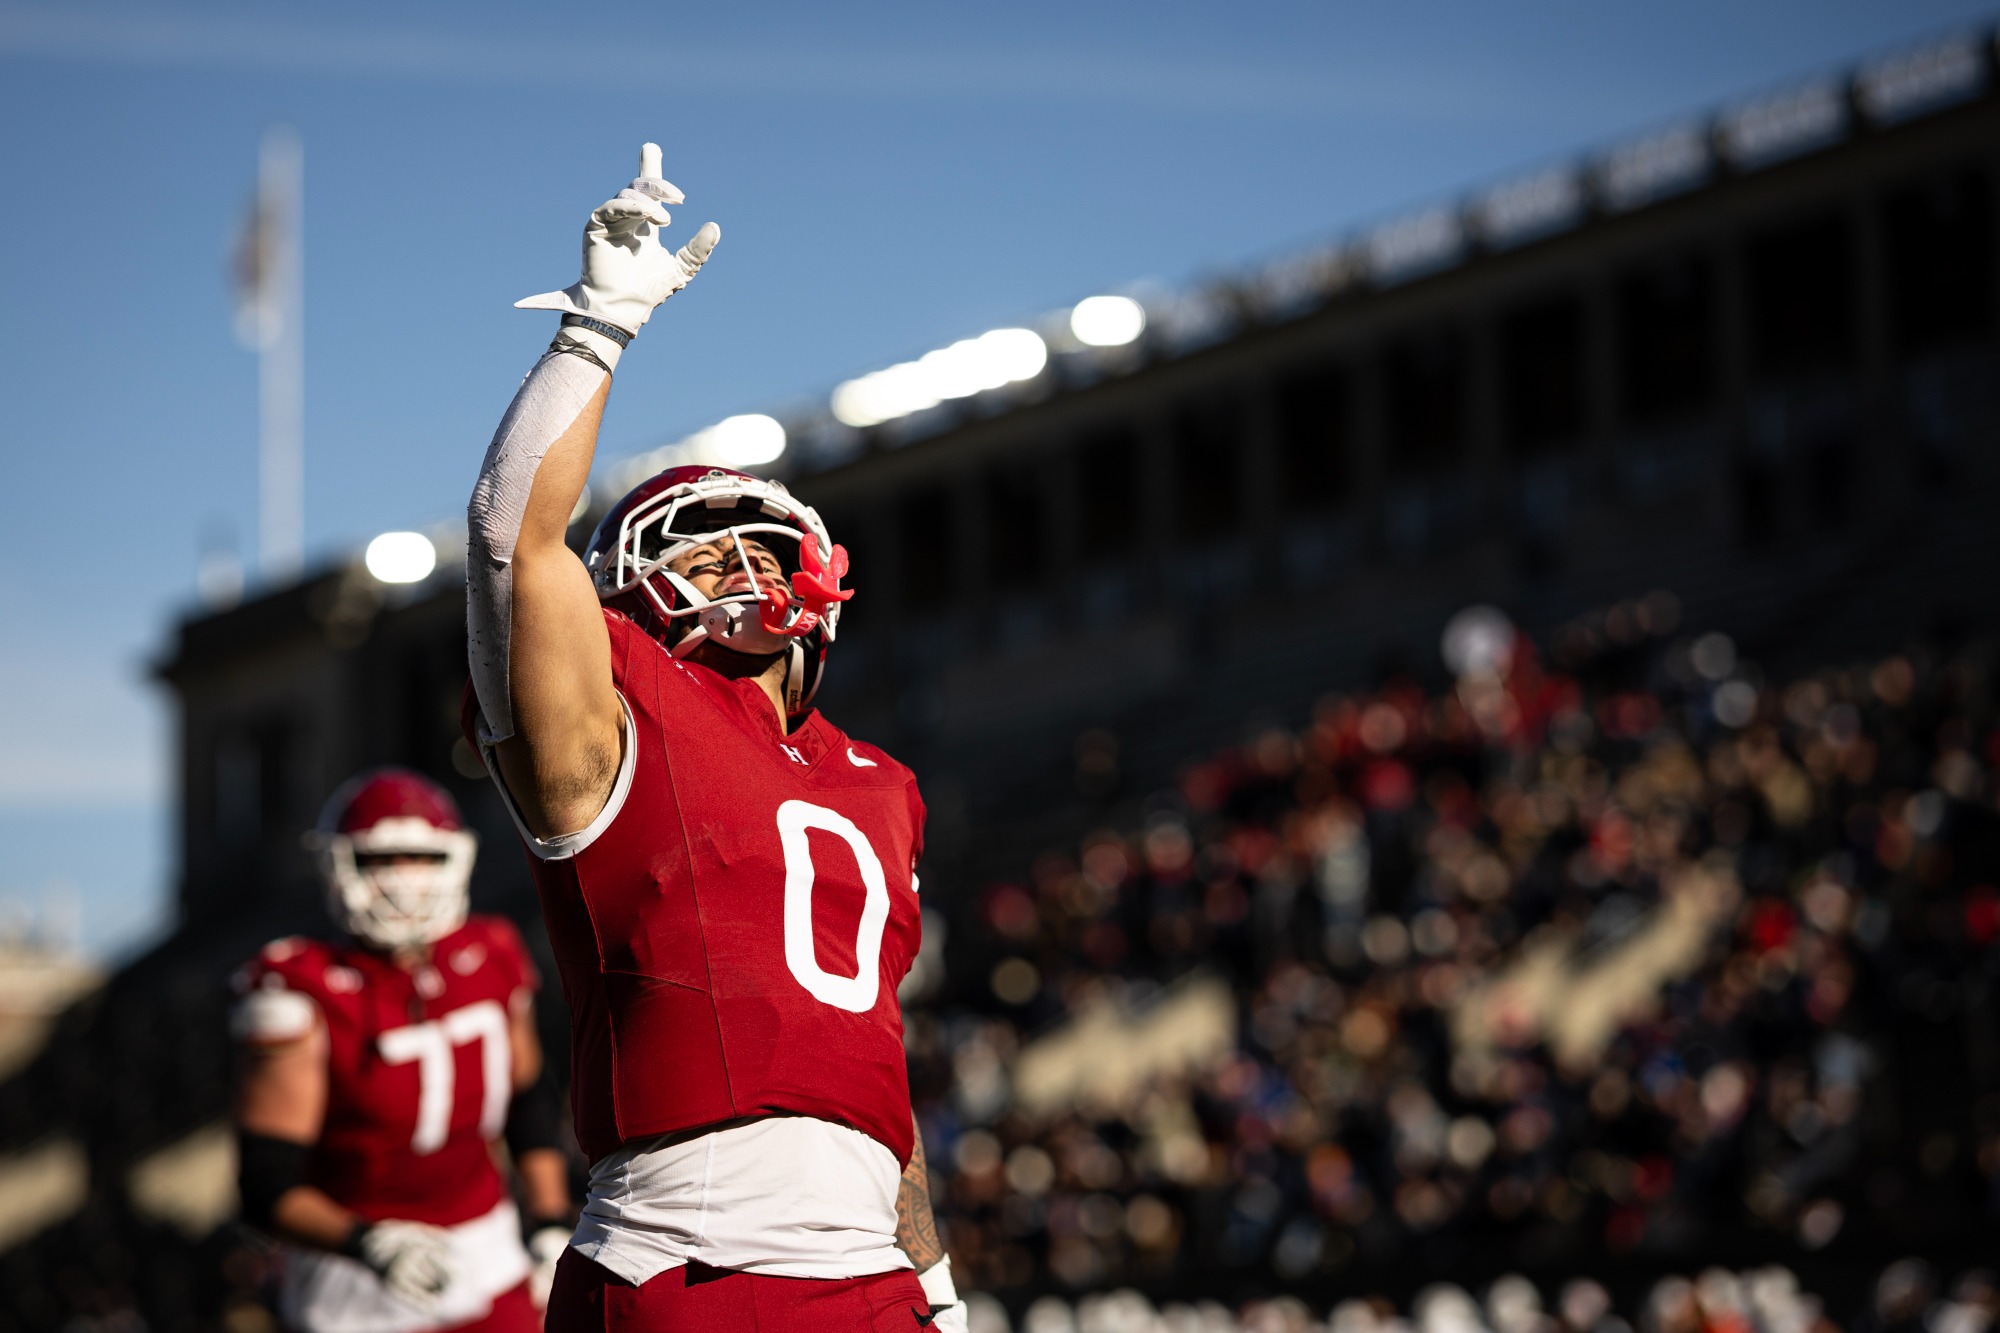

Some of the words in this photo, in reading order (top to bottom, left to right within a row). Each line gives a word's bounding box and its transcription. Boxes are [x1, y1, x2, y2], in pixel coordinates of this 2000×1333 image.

[580, 316, 629, 347] #MIAST
[780, 743, 810, 766] H
[776, 799, 890, 1013] 0
[378, 999, 511, 1156] 77
